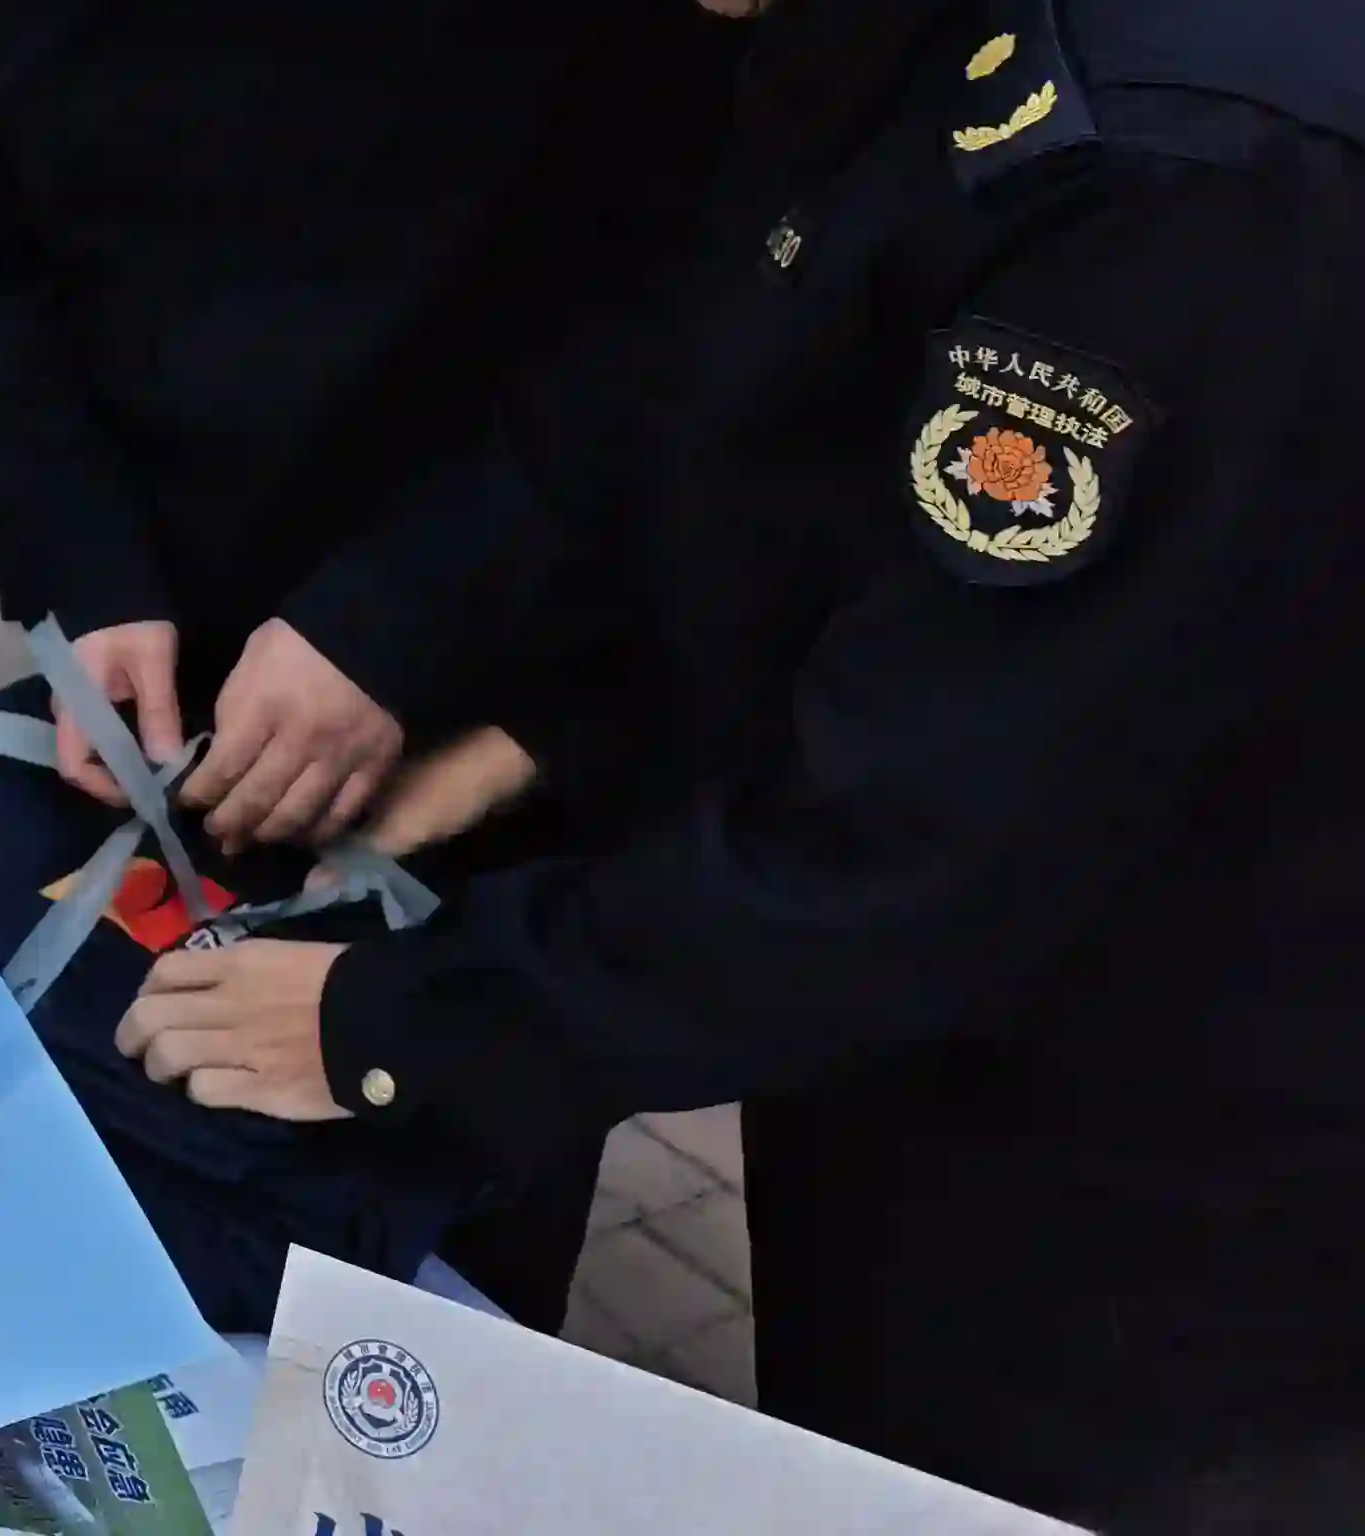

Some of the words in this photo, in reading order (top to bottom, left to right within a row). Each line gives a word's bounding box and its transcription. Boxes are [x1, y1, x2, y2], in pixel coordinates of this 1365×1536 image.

[948, 344, 1134, 434] 中华人民共和国
[953, 371, 1110, 449] 城市管理执法
[77, 1393, 151, 1502] 会应急
